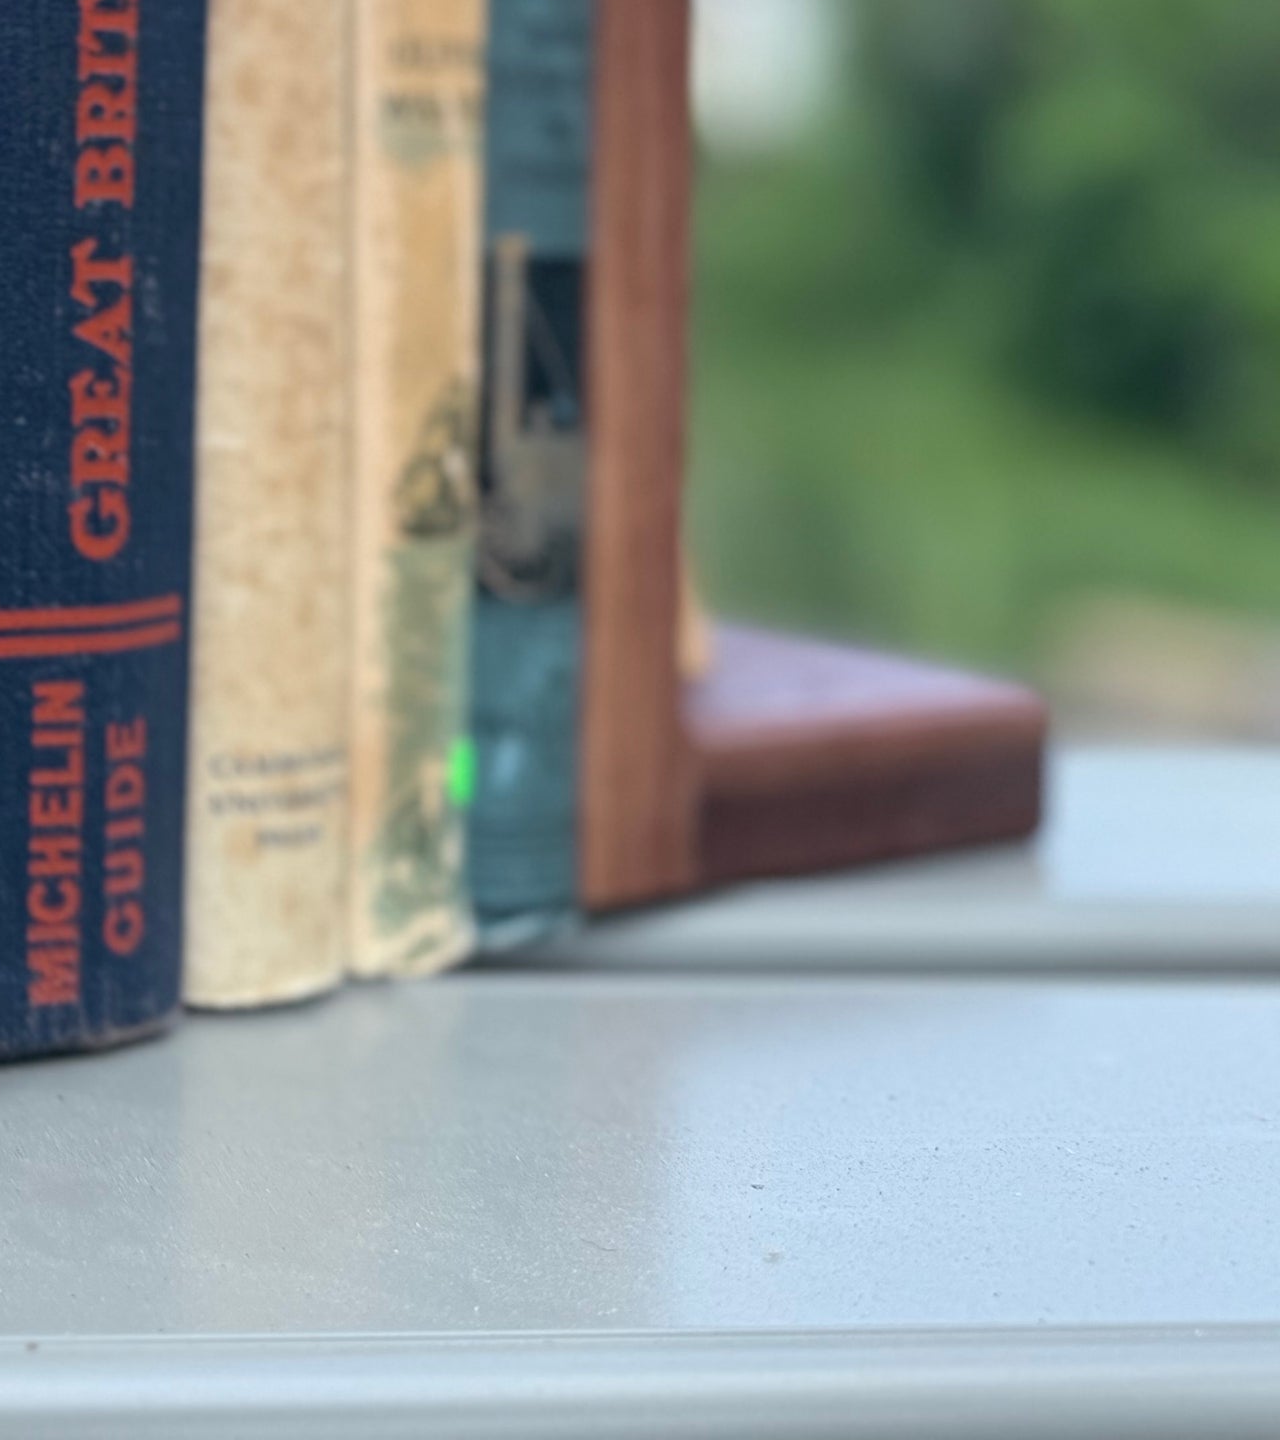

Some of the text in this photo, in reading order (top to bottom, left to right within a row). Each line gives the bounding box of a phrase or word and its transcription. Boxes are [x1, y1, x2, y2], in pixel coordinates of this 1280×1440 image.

[70, 237, 134, 561] GREAT
[26, 679, 86, 1008] MICHELIN
[102, 716, 147, 956] GUIDE
